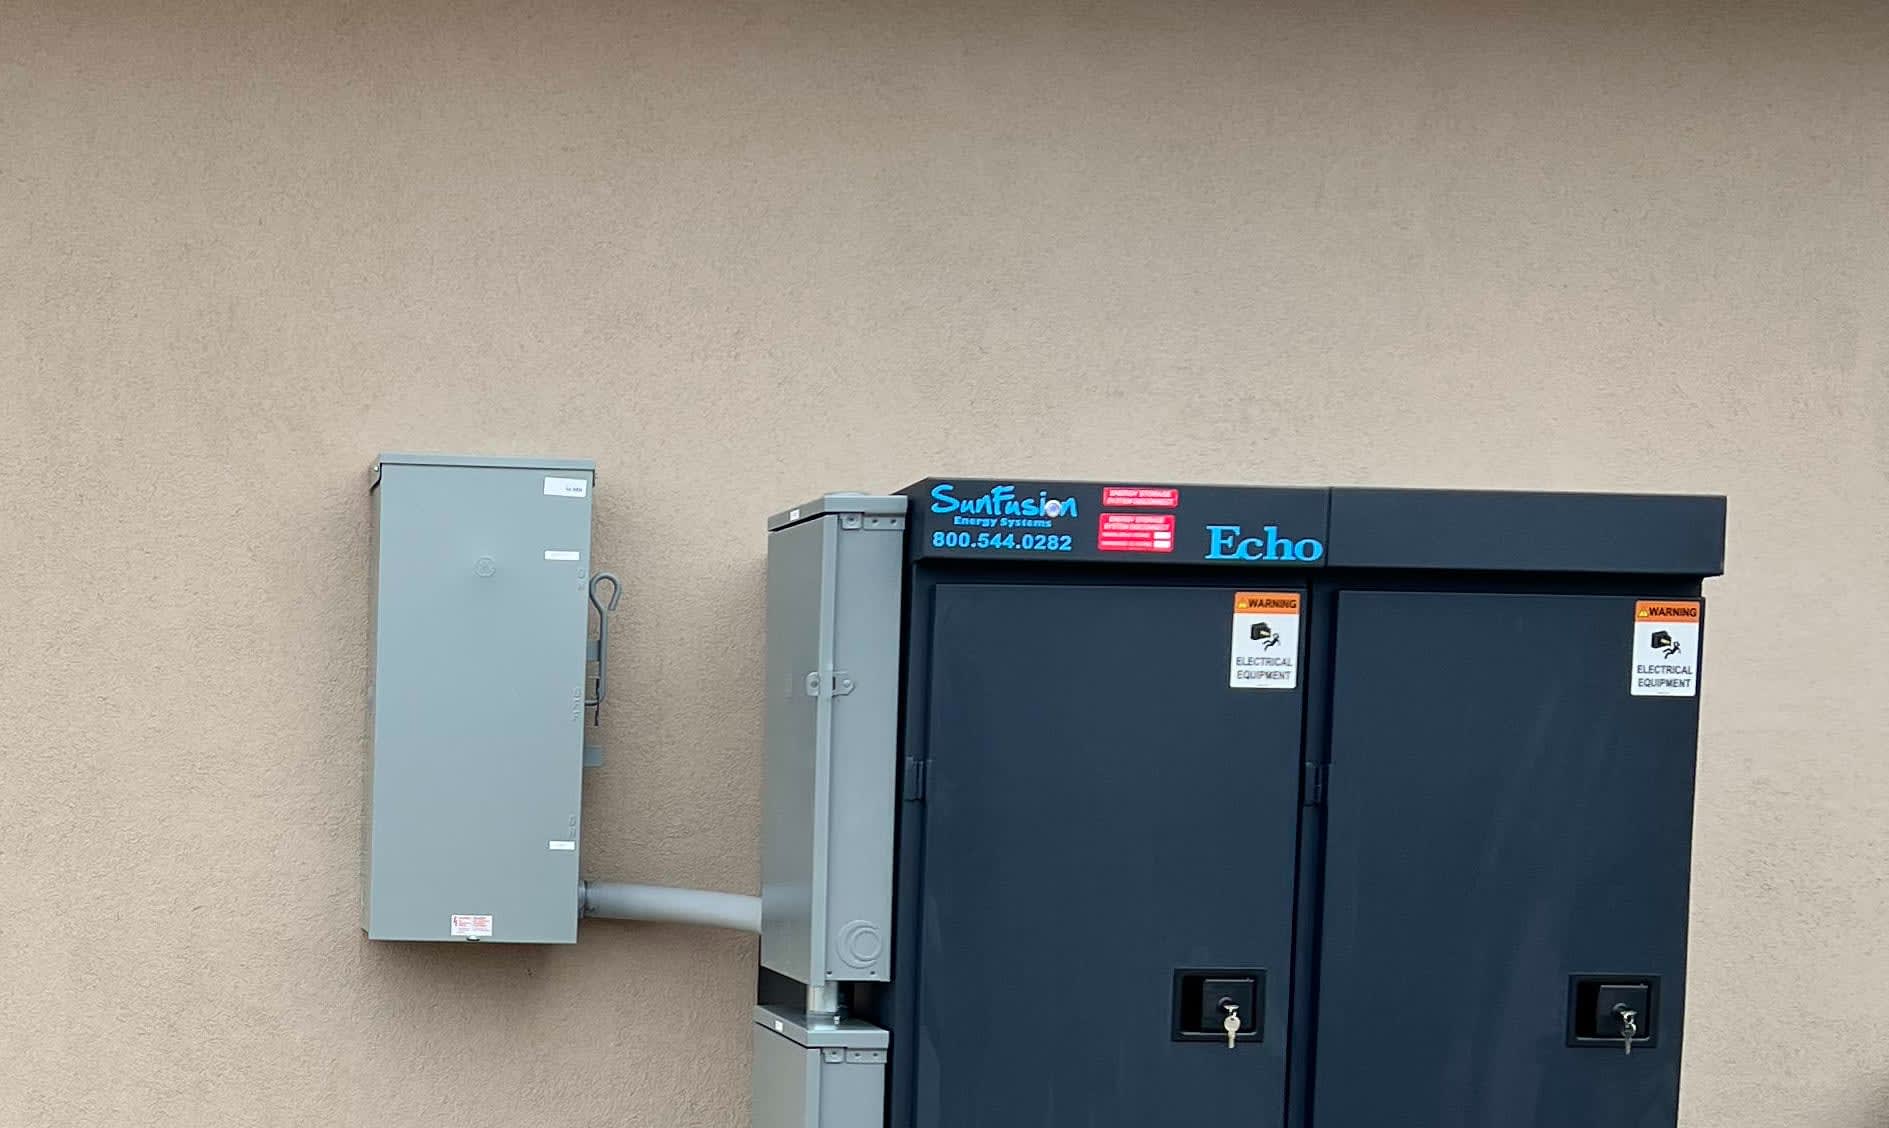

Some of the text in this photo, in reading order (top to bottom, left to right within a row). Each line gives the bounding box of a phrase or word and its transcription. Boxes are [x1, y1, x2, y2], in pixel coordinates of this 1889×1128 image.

[954, 515, 1052, 528] Energy Systems
[932, 531, 1073, 551] 800.544.0282
[1204, 525, 1324, 561] Echo
[1248, 599, 1297, 608] WARNING
[1649, 607, 1697, 617] WARNING
[1236, 657, 1293, 667] ELECTRICAL
[1637, 664, 1693, 675] ELECTRICAL
[1237, 670, 1291, 680] EQUIPMENT
[1638, 678, 1691, 688] EQUIPMENT
